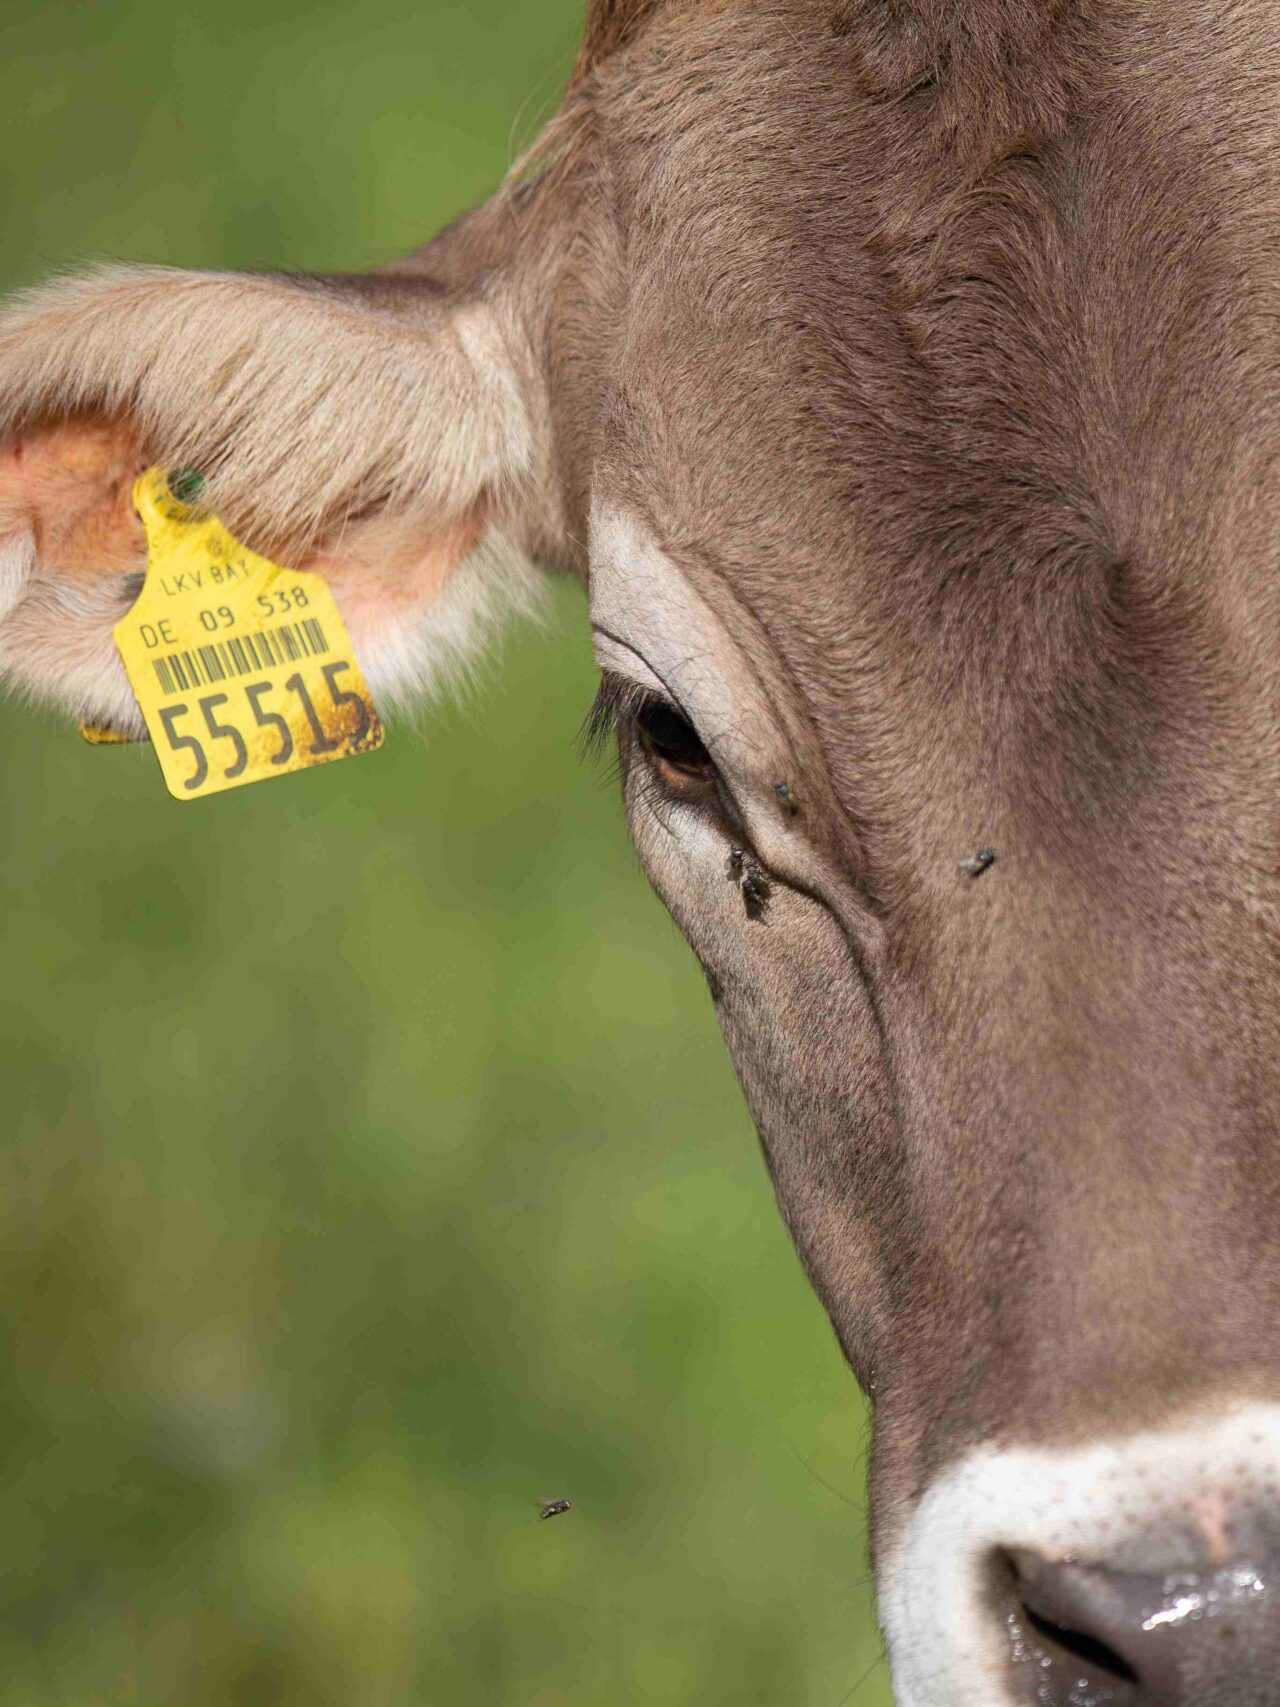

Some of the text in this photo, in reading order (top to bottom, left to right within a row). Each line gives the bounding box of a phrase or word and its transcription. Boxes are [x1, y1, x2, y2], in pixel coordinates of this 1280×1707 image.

[160, 558, 251, 597] LKV BAY
[140, 586, 309, 649] DE 09 538
[158, 660, 372, 791] 55515
